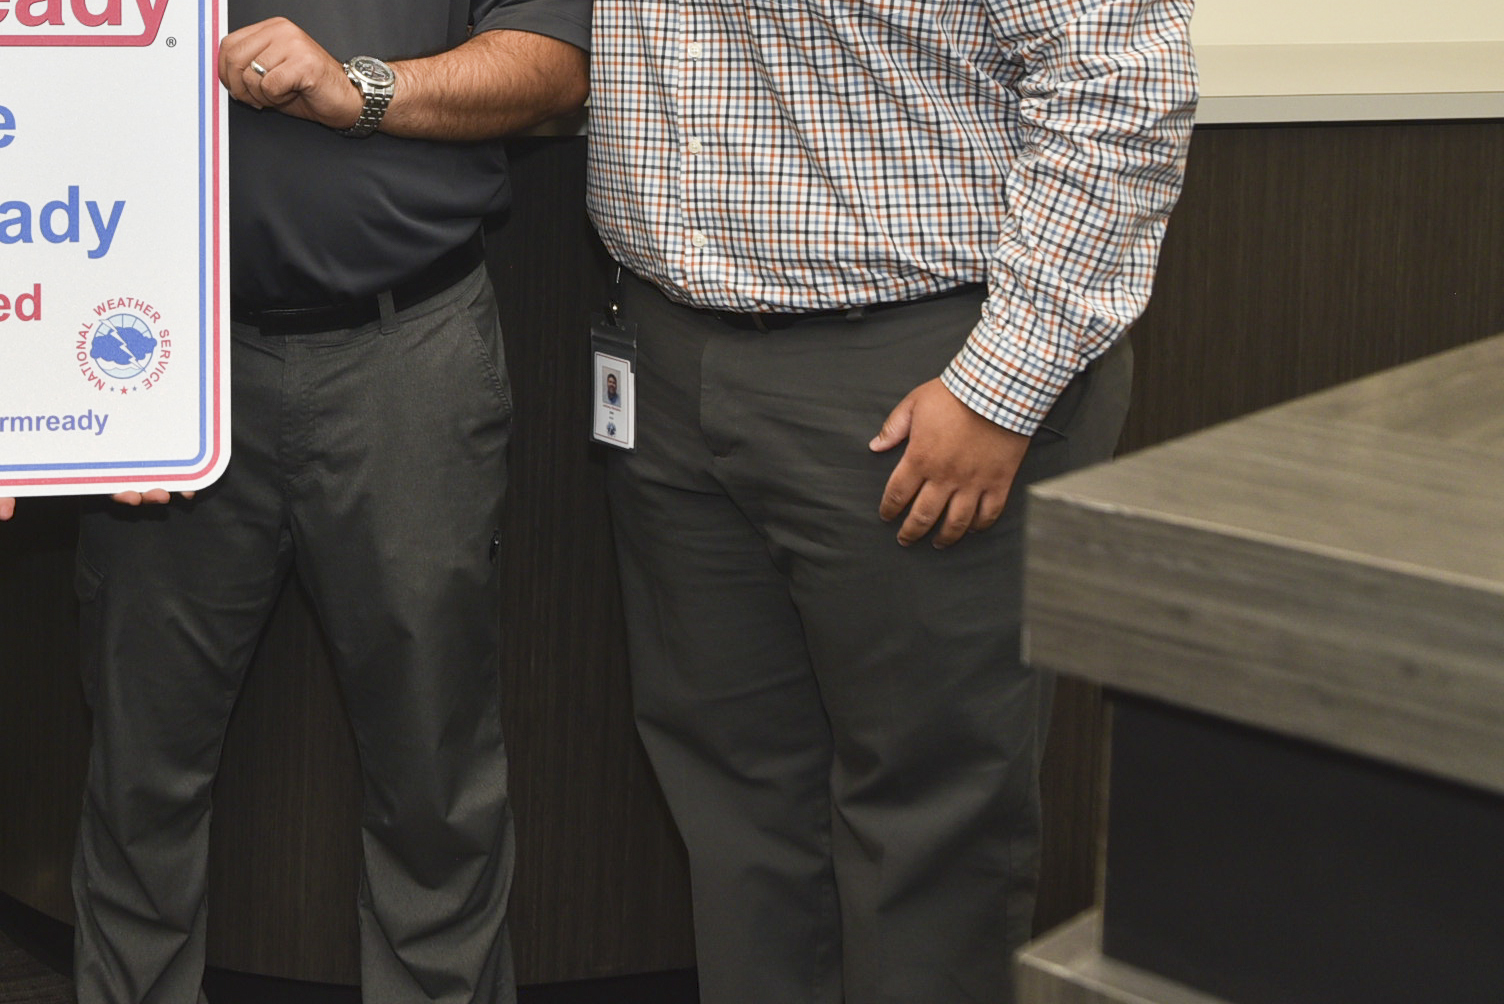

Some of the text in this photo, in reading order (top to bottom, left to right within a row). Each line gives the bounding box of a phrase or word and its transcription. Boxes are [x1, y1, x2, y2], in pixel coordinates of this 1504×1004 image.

[76, 297, 172, 391] NATIONAL WEATHER SERVICE
